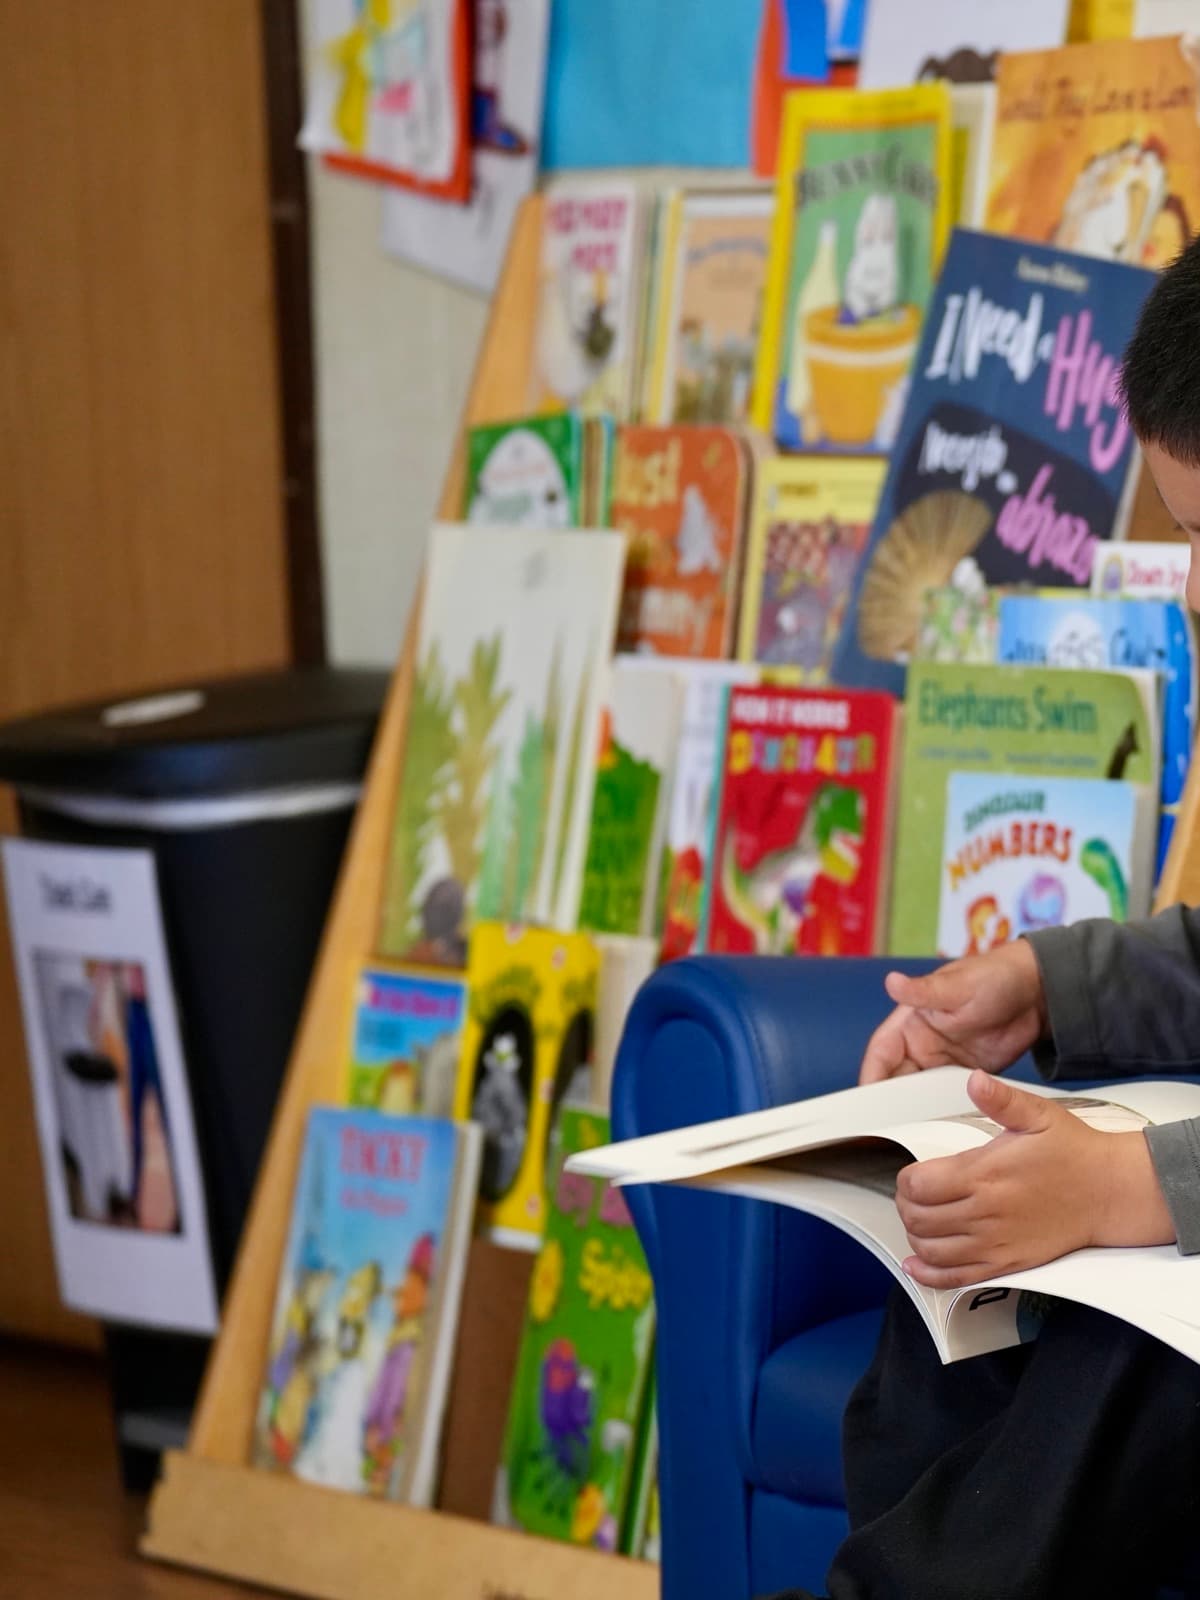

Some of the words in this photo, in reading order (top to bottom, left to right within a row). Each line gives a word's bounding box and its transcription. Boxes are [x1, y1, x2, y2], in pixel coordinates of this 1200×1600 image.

[948, 286, 1043, 383] Need
[918, 679, 1028, 734] Elephants
[1032, 685, 1098, 734] Swim
[947, 820, 1073, 892] NUMBERS
